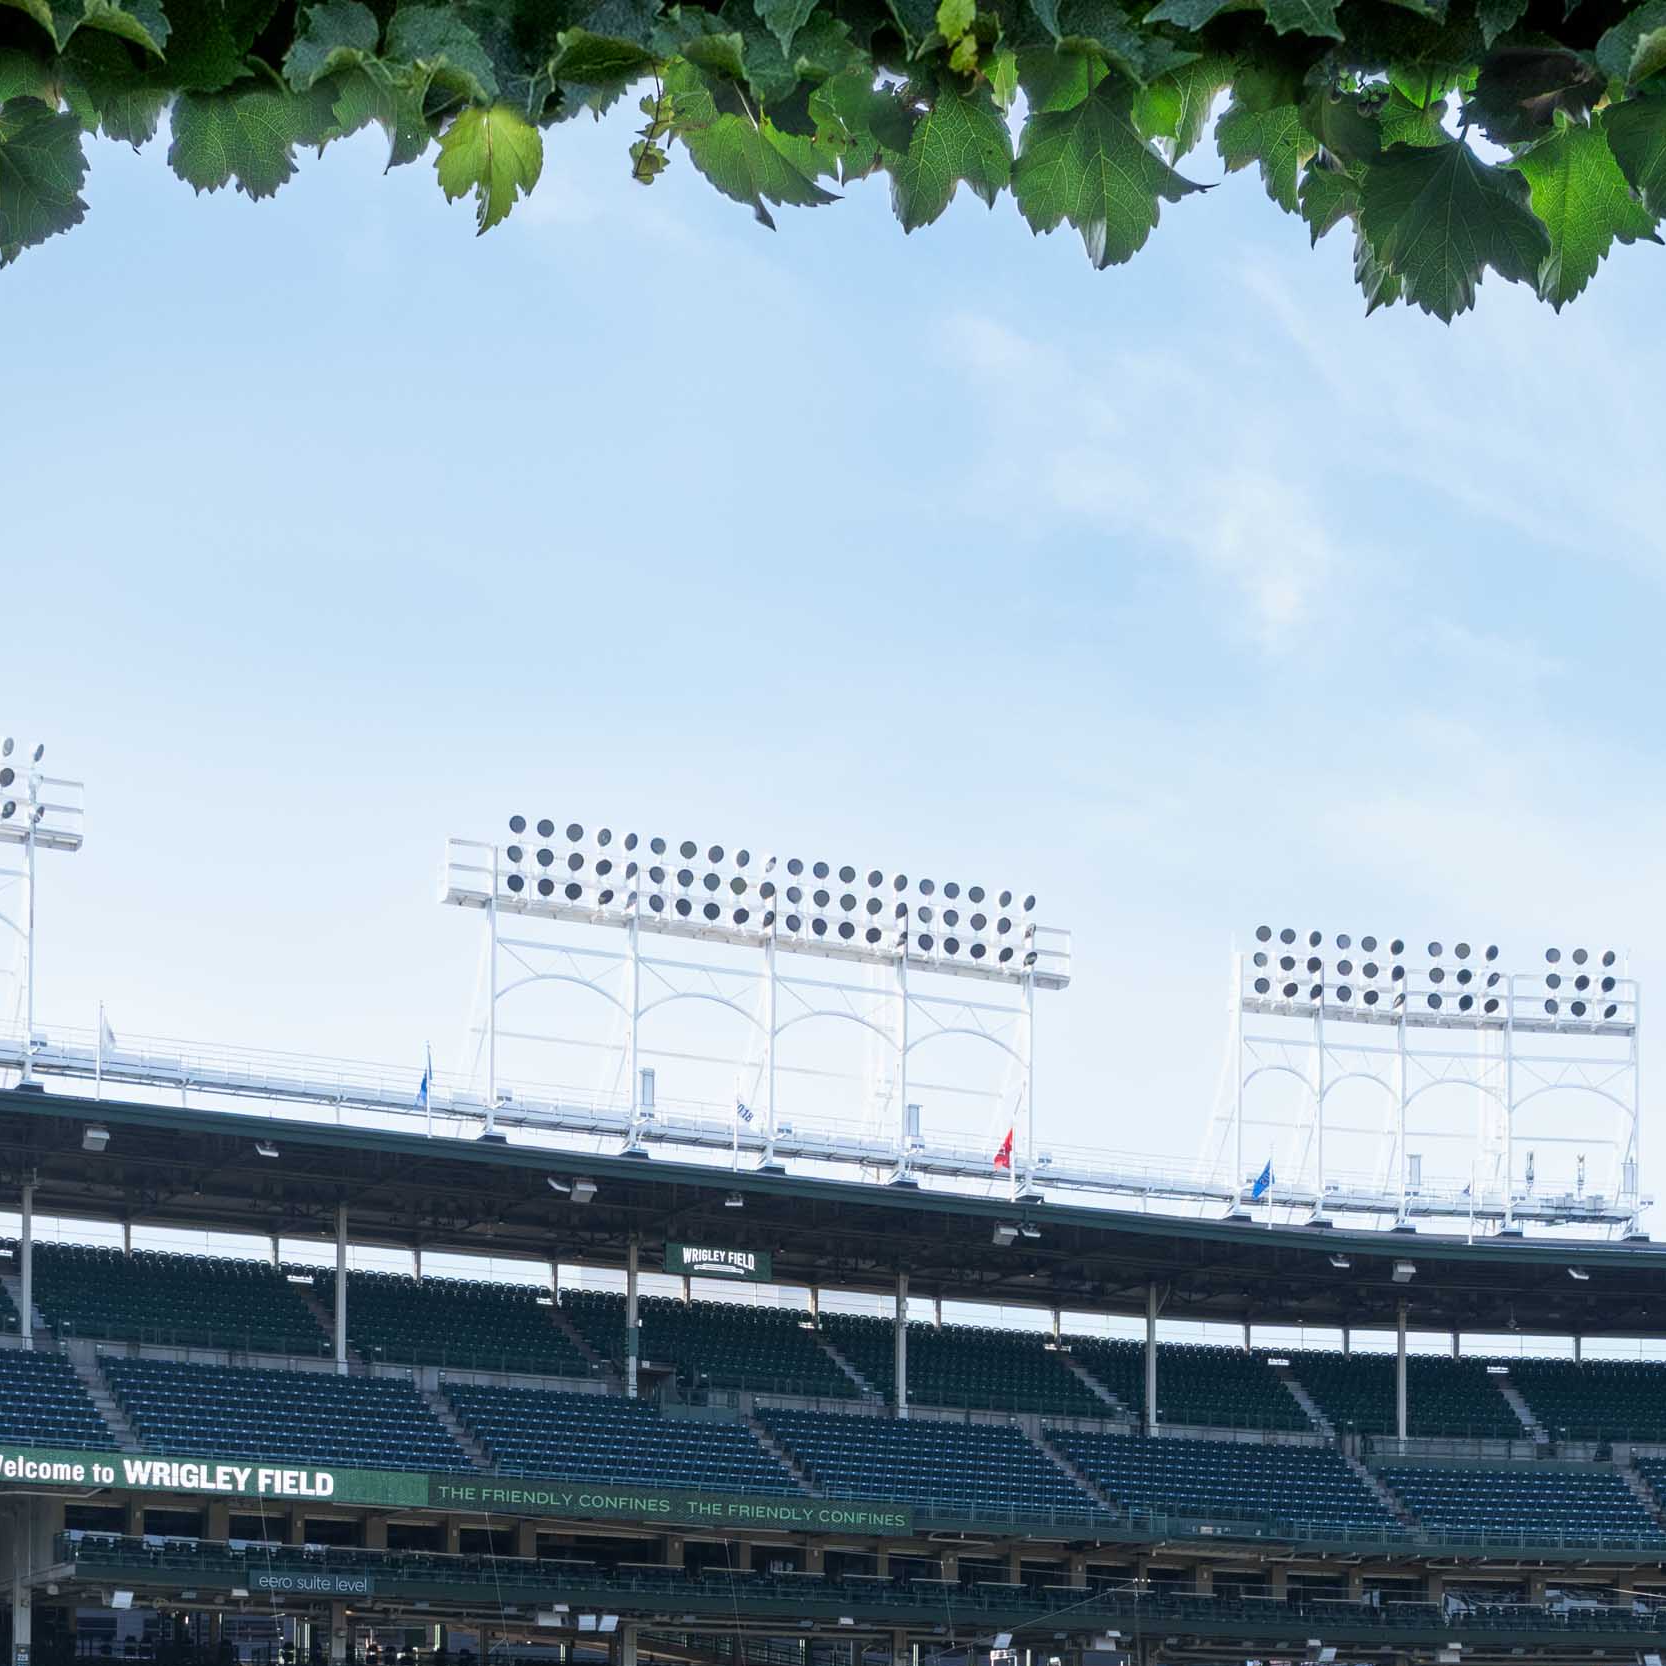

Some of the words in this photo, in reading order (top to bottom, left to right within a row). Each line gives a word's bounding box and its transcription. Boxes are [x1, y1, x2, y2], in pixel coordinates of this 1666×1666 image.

[683, 1247, 726, 1264] WRIGLEY
[728, 1251, 755, 1270] FIELD
[92, 1463, 115, 1484] to
[123, 1459, 251, 1492] WRIGLEY
[258, 1468, 334, 1497] FIELD
[438, 1486, 477, 1500] THE
[482, 1488, 573, 1506] FRIENDLY
[579, 1494, 670, 1512] CONFINES
[687, 1501, 722, 1516] THE
[728, 1504, 813, 1521] FRIENDLY
[259, 1576, 292, 1589] eero
[297, 1575, 331, 1590] suite
[335, 1575, 367, 1592] level
